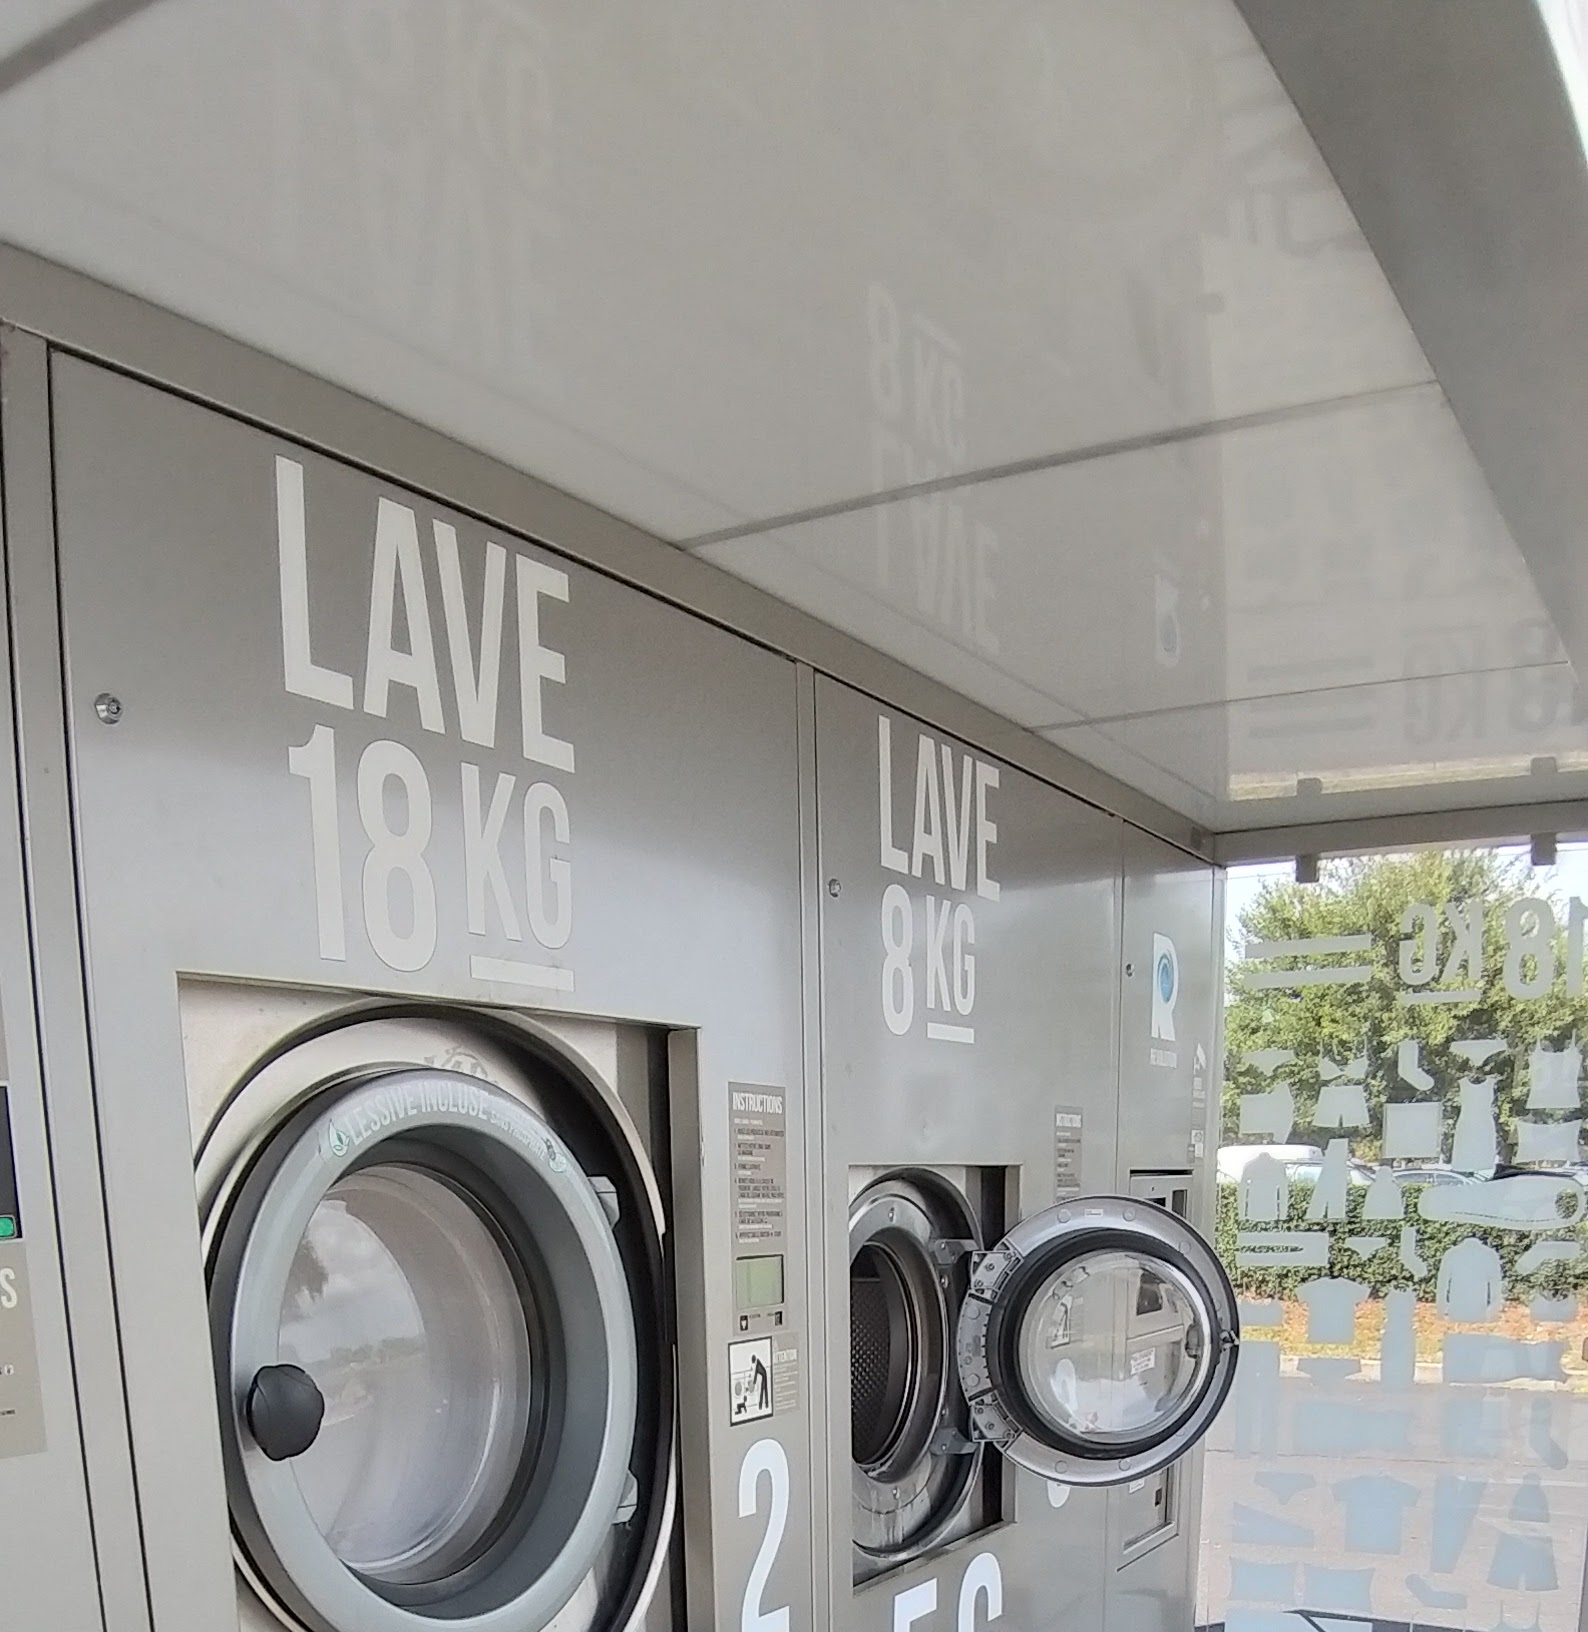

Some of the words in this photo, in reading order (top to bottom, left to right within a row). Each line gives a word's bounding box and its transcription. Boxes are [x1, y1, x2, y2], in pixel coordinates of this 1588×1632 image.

[276, 455, 575, 773] LAVE
[289, 724, 437, 973] 18
[461, 762, 572, 950] KG
[878, 714, 1000, 901] LAVE
[881, 884, 914, 1035] 8
[926, 894, 975, 1015] KG
[346, 1085, 417, 1146] LESSIVE
[418, 1079, 488, 1120] INCLUSE
[732, 1091, 783, 1114] INSTRUCTIONS
